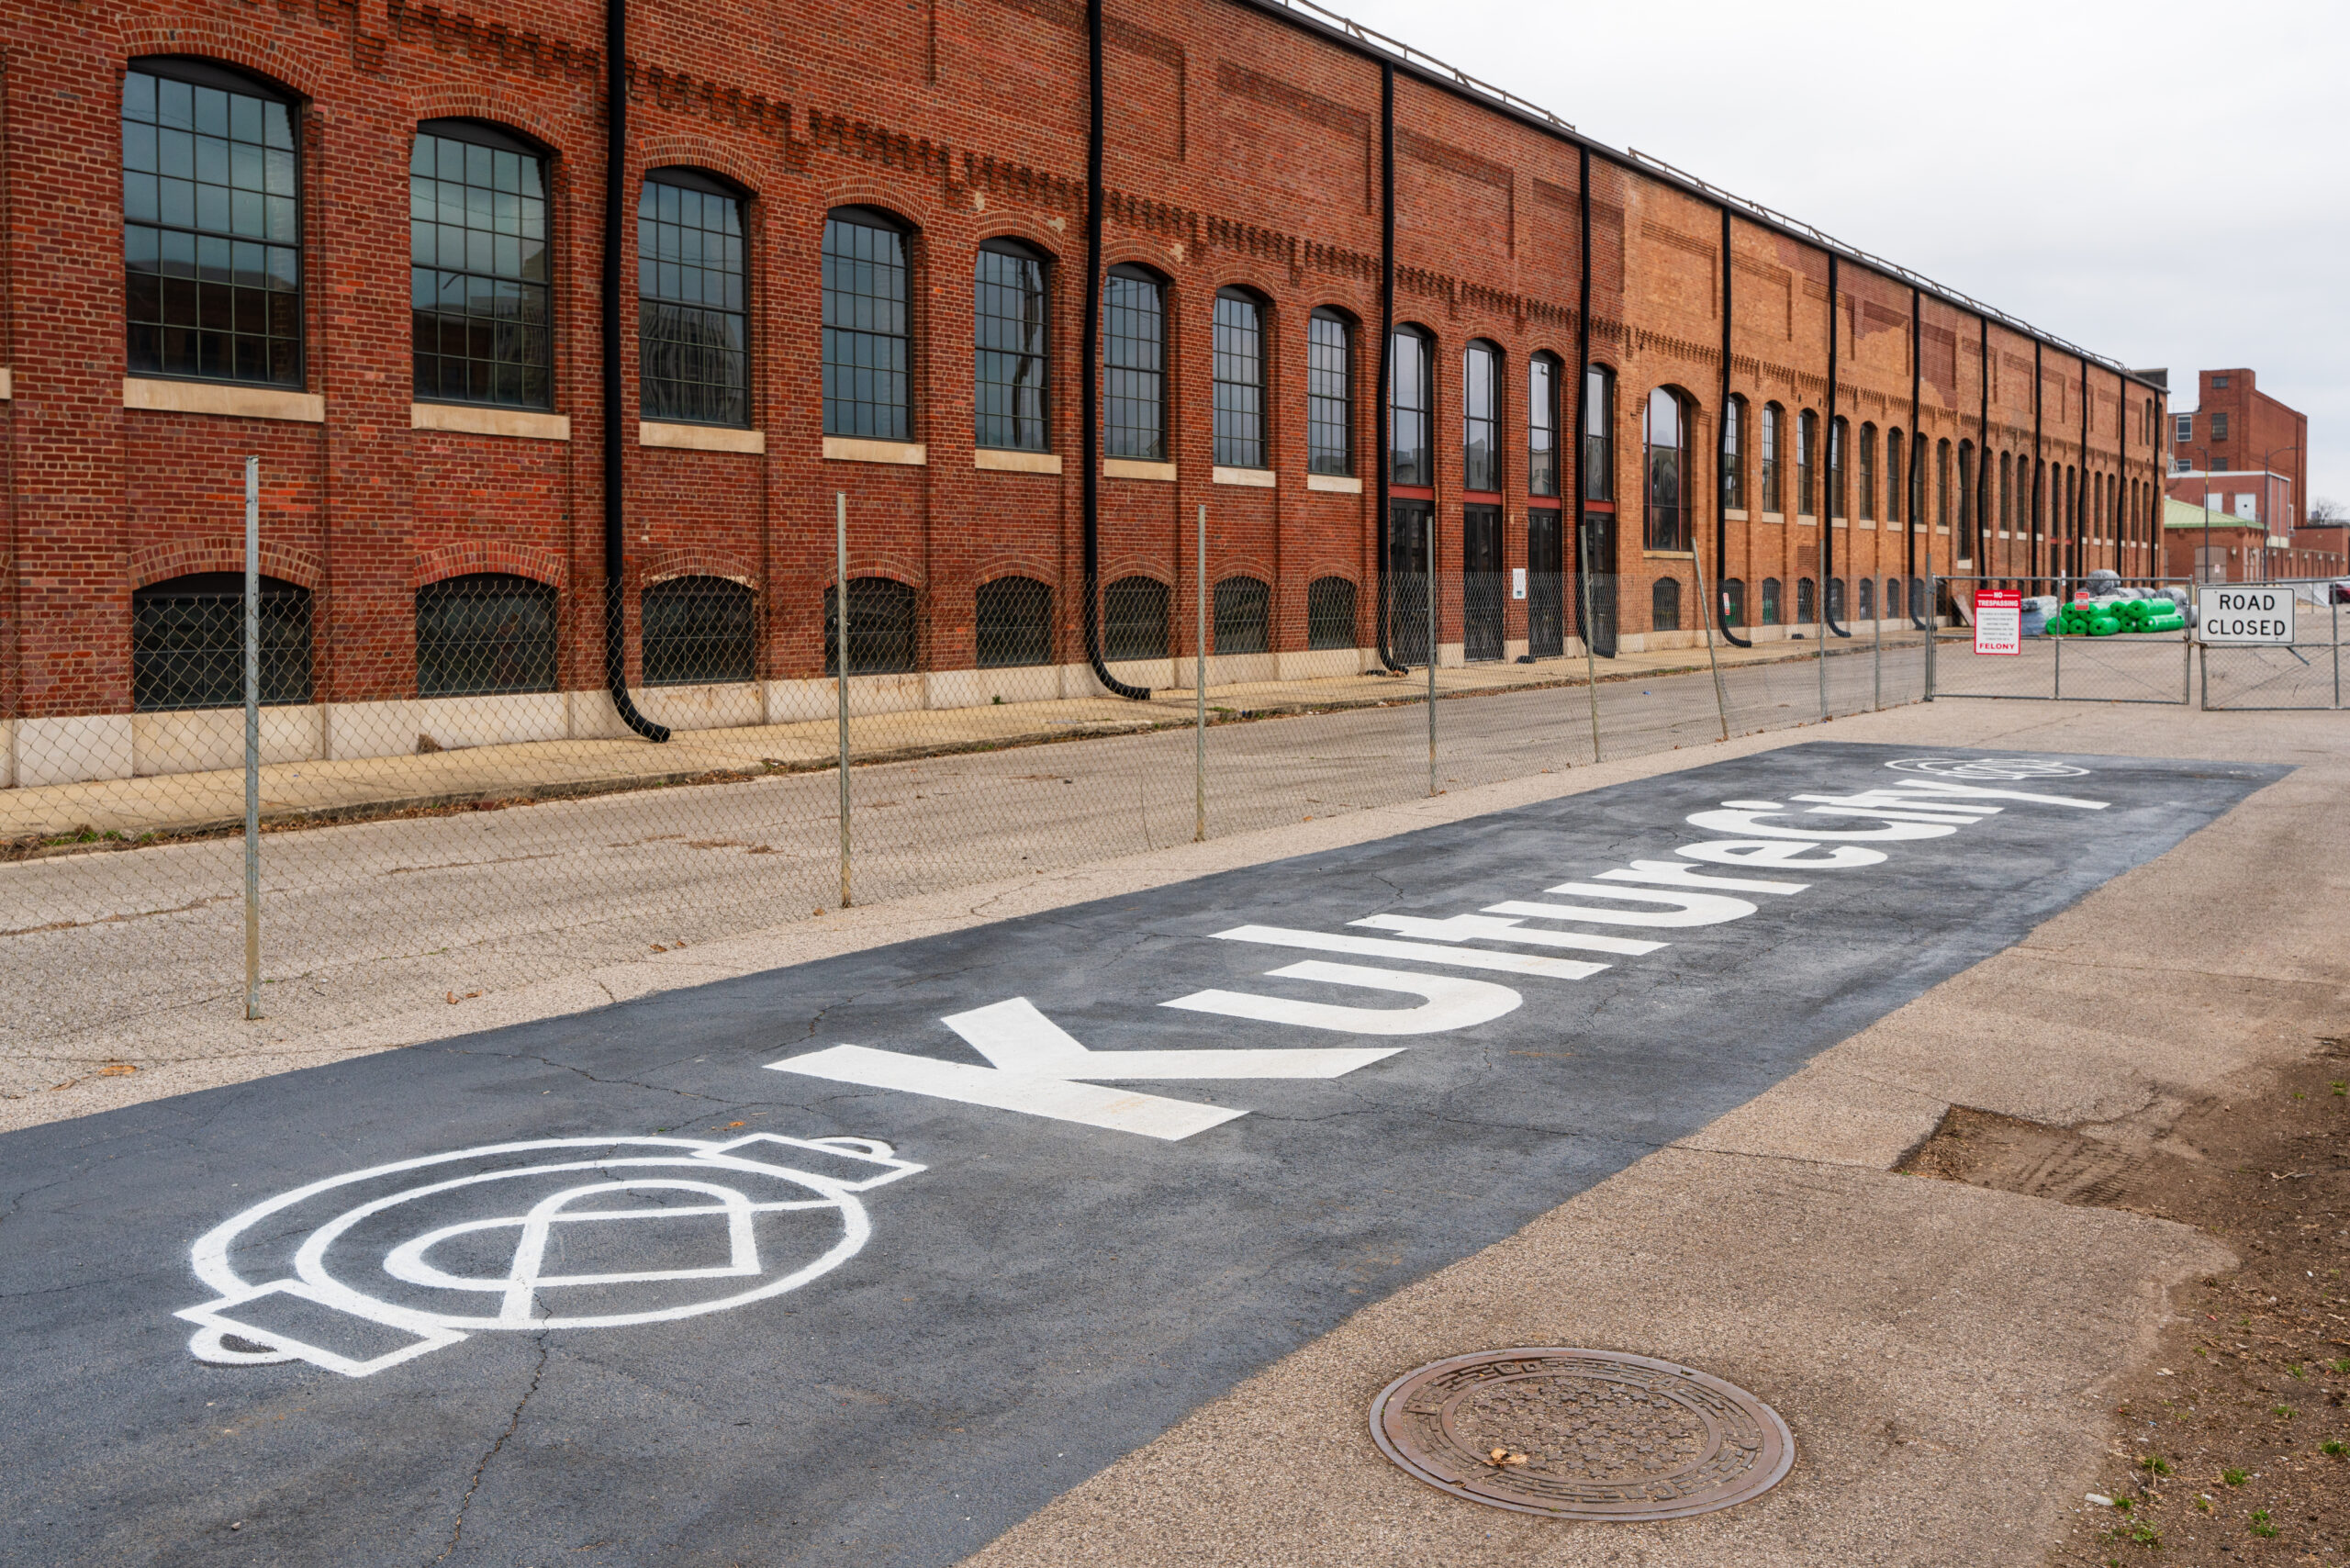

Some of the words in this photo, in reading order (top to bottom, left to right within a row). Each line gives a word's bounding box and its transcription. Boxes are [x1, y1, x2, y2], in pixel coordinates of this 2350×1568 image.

[2220, 594, 2275, 610] ROAD
[2208, 619, 2286, 636] CLOSED
[765, 778, 2111, 1143] KultureCity
